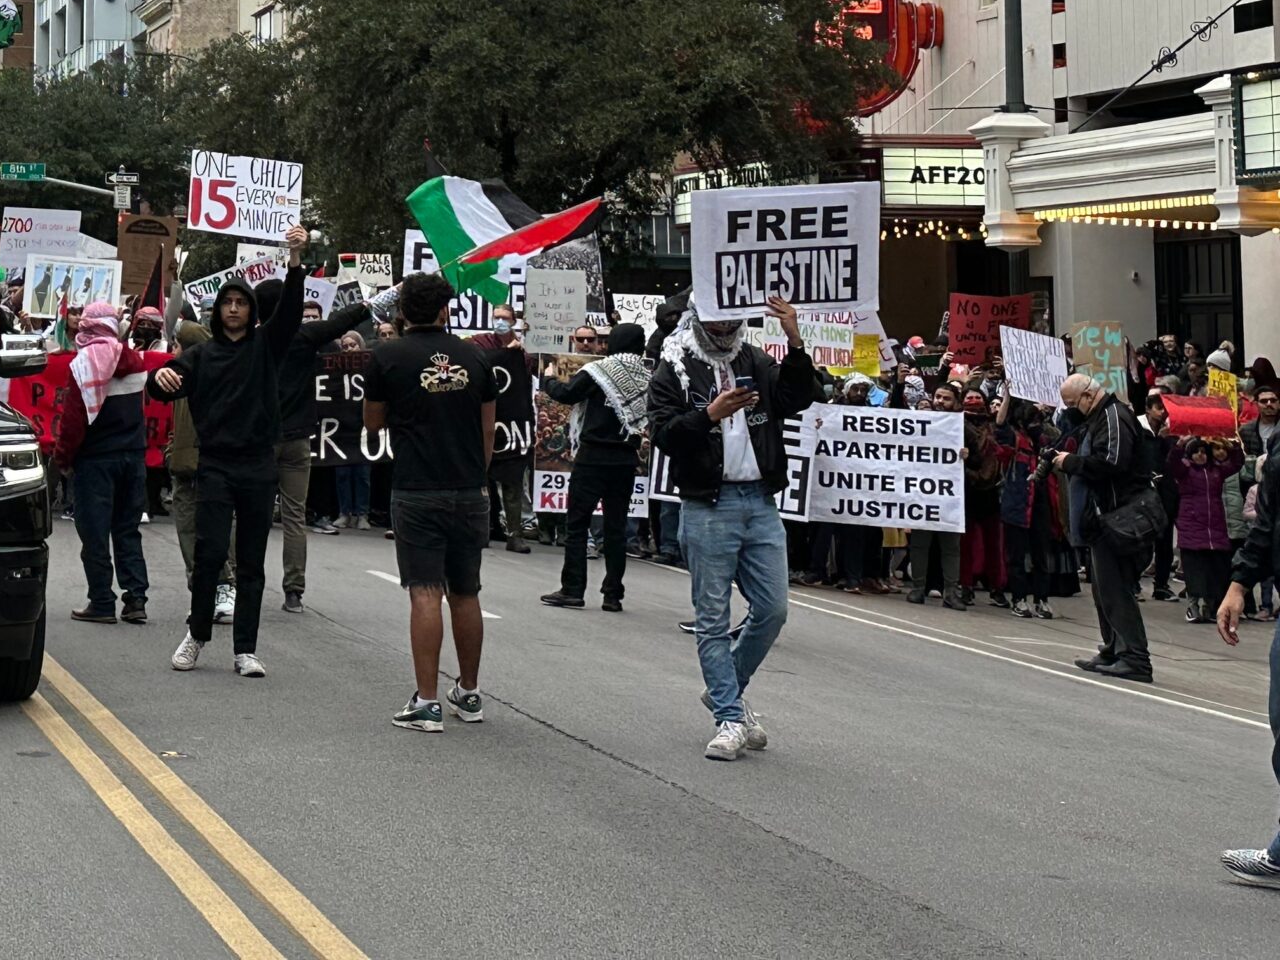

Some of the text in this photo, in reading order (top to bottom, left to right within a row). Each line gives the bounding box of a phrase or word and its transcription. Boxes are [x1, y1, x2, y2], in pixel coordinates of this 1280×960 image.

[195, 150, 302, 192] ONE CHILD
[190, 177, 276, 230] 15 EVERY
[238, 207, 295, 234] MINUTES
[727, 205, 849, 243] FREE
[721, 248, 852, 307] PALESTINE
[957, 299, 1020, 317] NO ONE
[841, 414, 932, 437] RESIST
[815, 440, 958, 465] APARTHEID
[817, 471, 955, 497] UNITE FOR
[831, 498, 941, 522] JUSTICE
